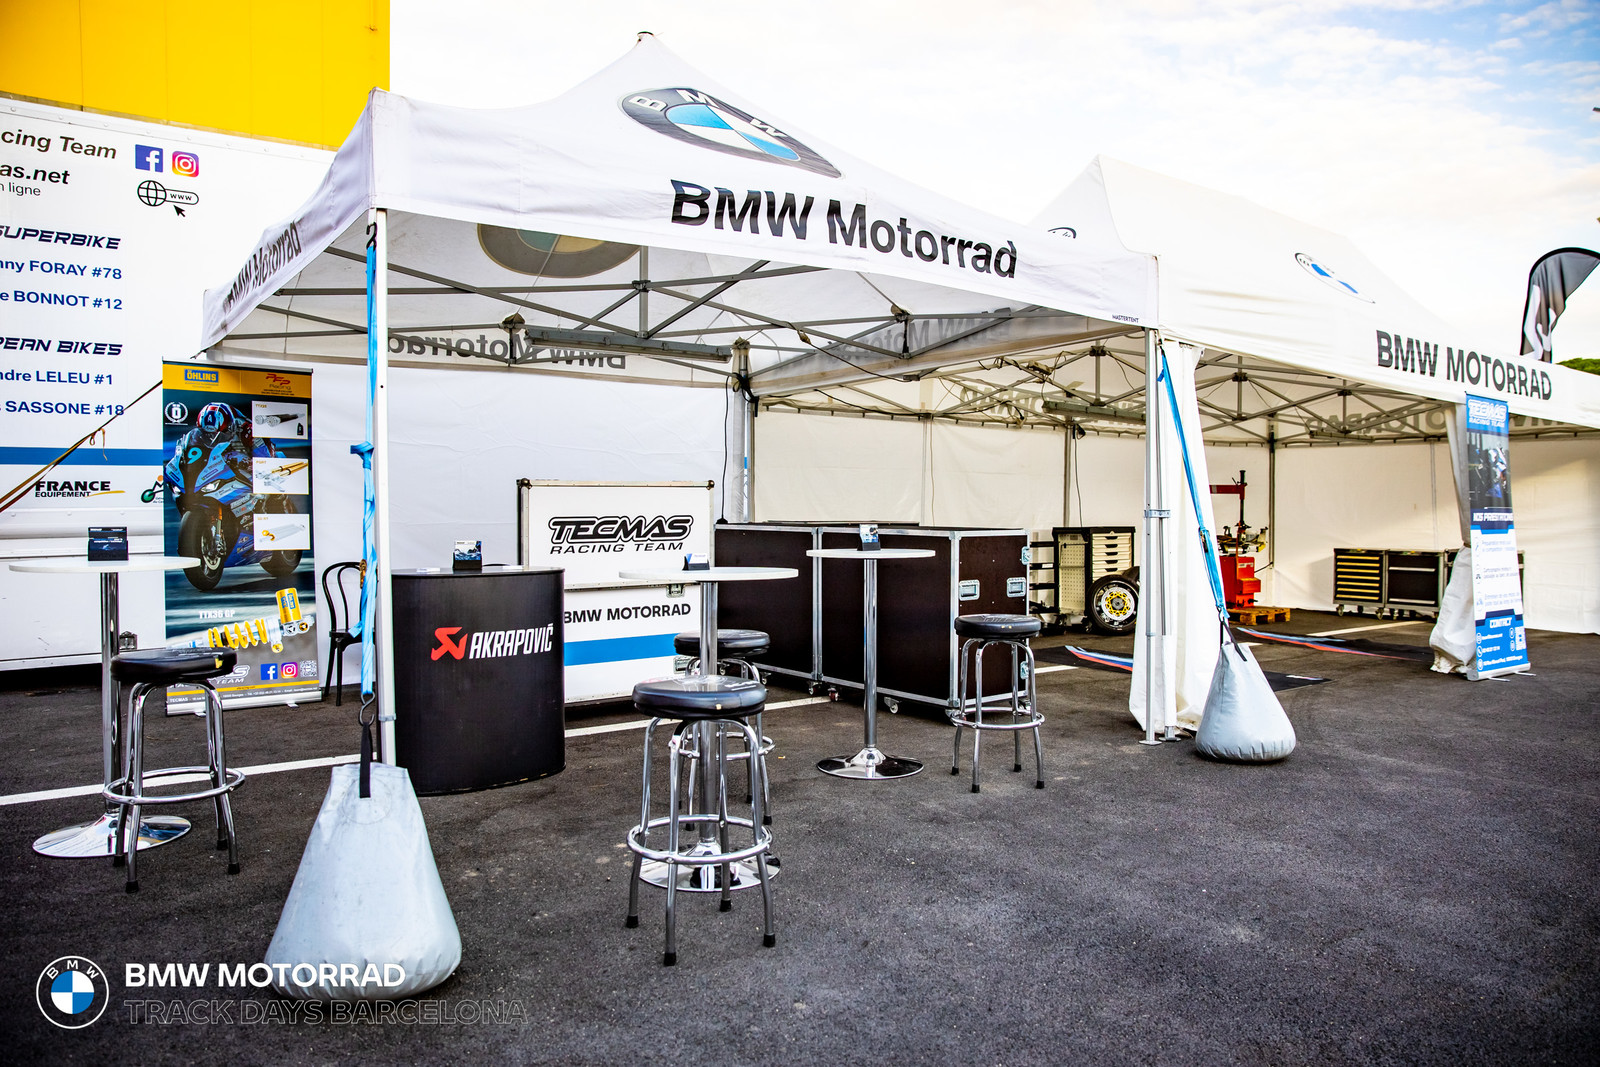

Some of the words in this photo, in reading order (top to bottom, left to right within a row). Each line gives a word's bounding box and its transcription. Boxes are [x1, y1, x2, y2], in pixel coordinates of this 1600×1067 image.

[1, 129, 52, 153] cing
[59, 136, 117, 159] Team
[0, 164, 70, 184] as.net
[9, 181, 41, 196] ligne
[671, 179, 814, 240] BMW
[827, 199, 1017, 278] Motorrad
[29, 260, 87, 276] FORAY
[91, 267, 122, 280] #78
[13, 290, 89, 307] BONNOT
[92, 298, 122, 310] #12
[57, 341, 123, 356] BIKES
[1376, 330, 1438, 377] BMW
[1447, 347, 1552, 400] MOTORRAD
[36, 370, 90, 384] LELEU
[94, 374, 113, 385] #1
[186, 369, 217, 382] ÖHLINS
[5, 400, 91, 415] SASSONE
[94, 404, 124, 416] #18
[35, 481, 111, 491] FRANCE
[548, 515, 694, 544] TECMAS
[550, 544, 625, 554] RACING
[634, 542, 684, 551] TEAM
[564, 609, 602, 623] BMW
[607, 603, 692, 620] MOTORRAD
